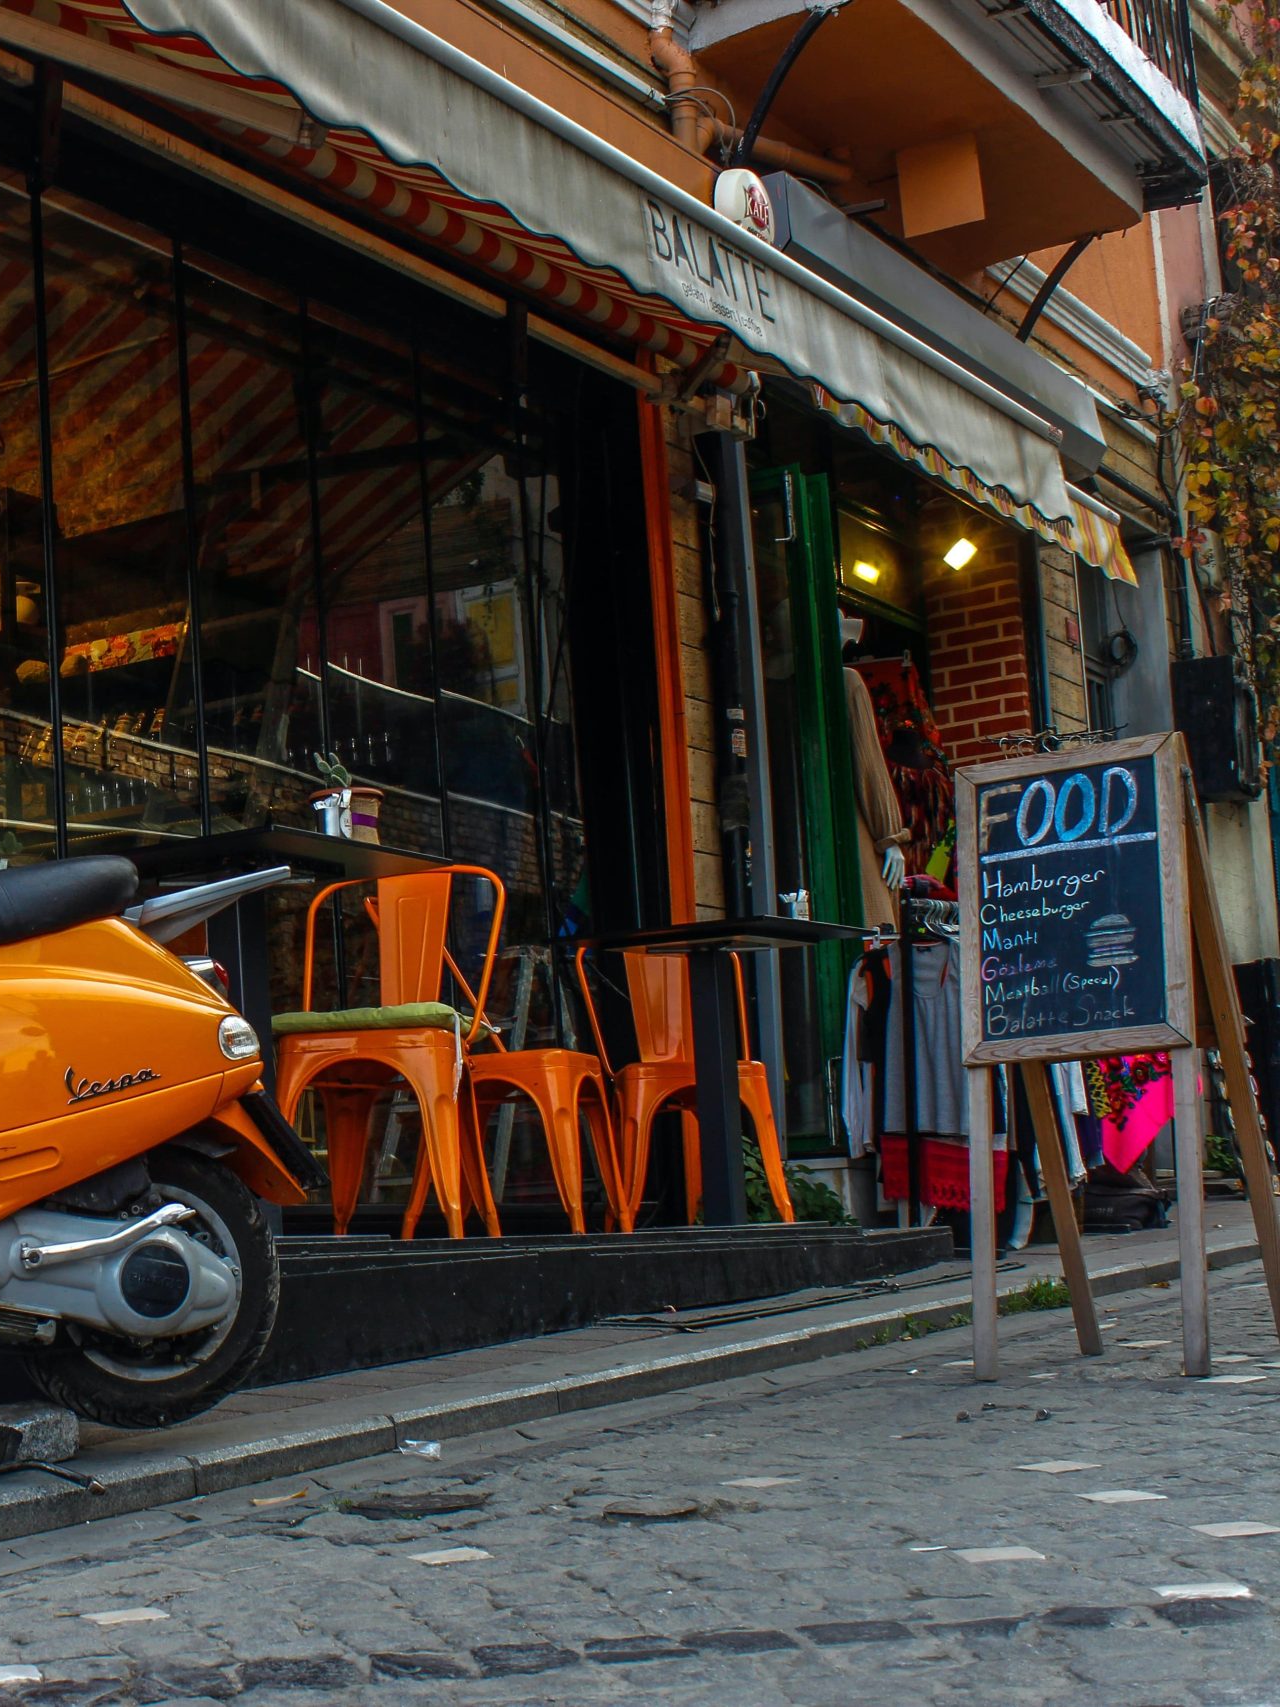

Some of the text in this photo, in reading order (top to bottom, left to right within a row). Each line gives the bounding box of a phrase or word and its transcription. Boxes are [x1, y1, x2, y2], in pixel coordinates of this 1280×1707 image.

[648, 200, 775, 324] BALATTE
[979, 767, 1137, 853] FOOD
[983, 864, 1105, 899] Hamburger
[980, 897, 1090, 925] Cheeseburger
[985, 974, 1059, 1005] Meatball
[988, 994, 1135, 1036] Balatte Snack
[64, 1066, 160, 1105] Vespa
